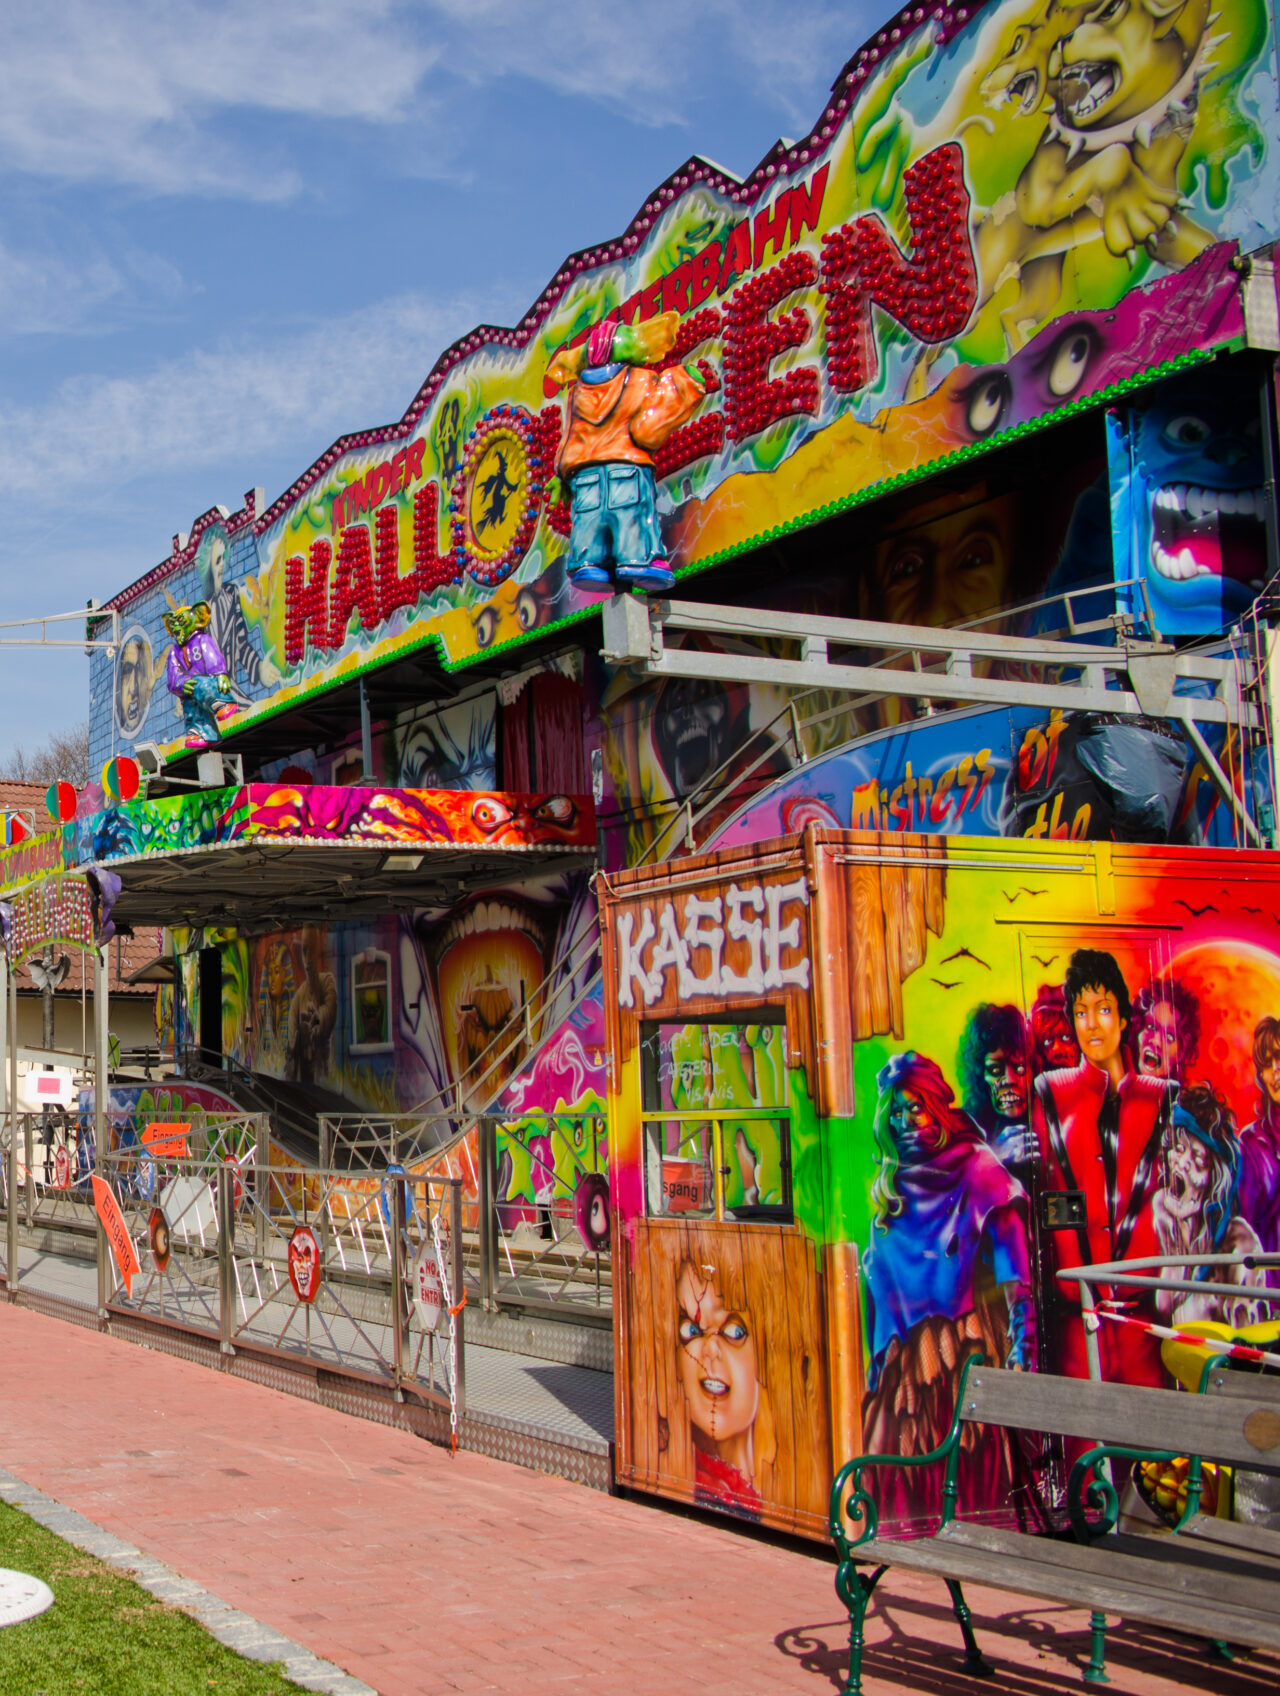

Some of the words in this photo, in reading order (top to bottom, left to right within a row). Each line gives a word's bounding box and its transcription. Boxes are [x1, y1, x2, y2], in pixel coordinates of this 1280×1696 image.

[332, 437, 426, 536] KINDER
[543, 160, 831, 398] TERBAHN
[191, 646, 202, 661] 8
[852, 748, 996, 832] Mistress
[616, 876, 810, 1009] KASSE
[102, 1195, 131, 1272] Eingang
[424, 1260, 437, 1278] NO
